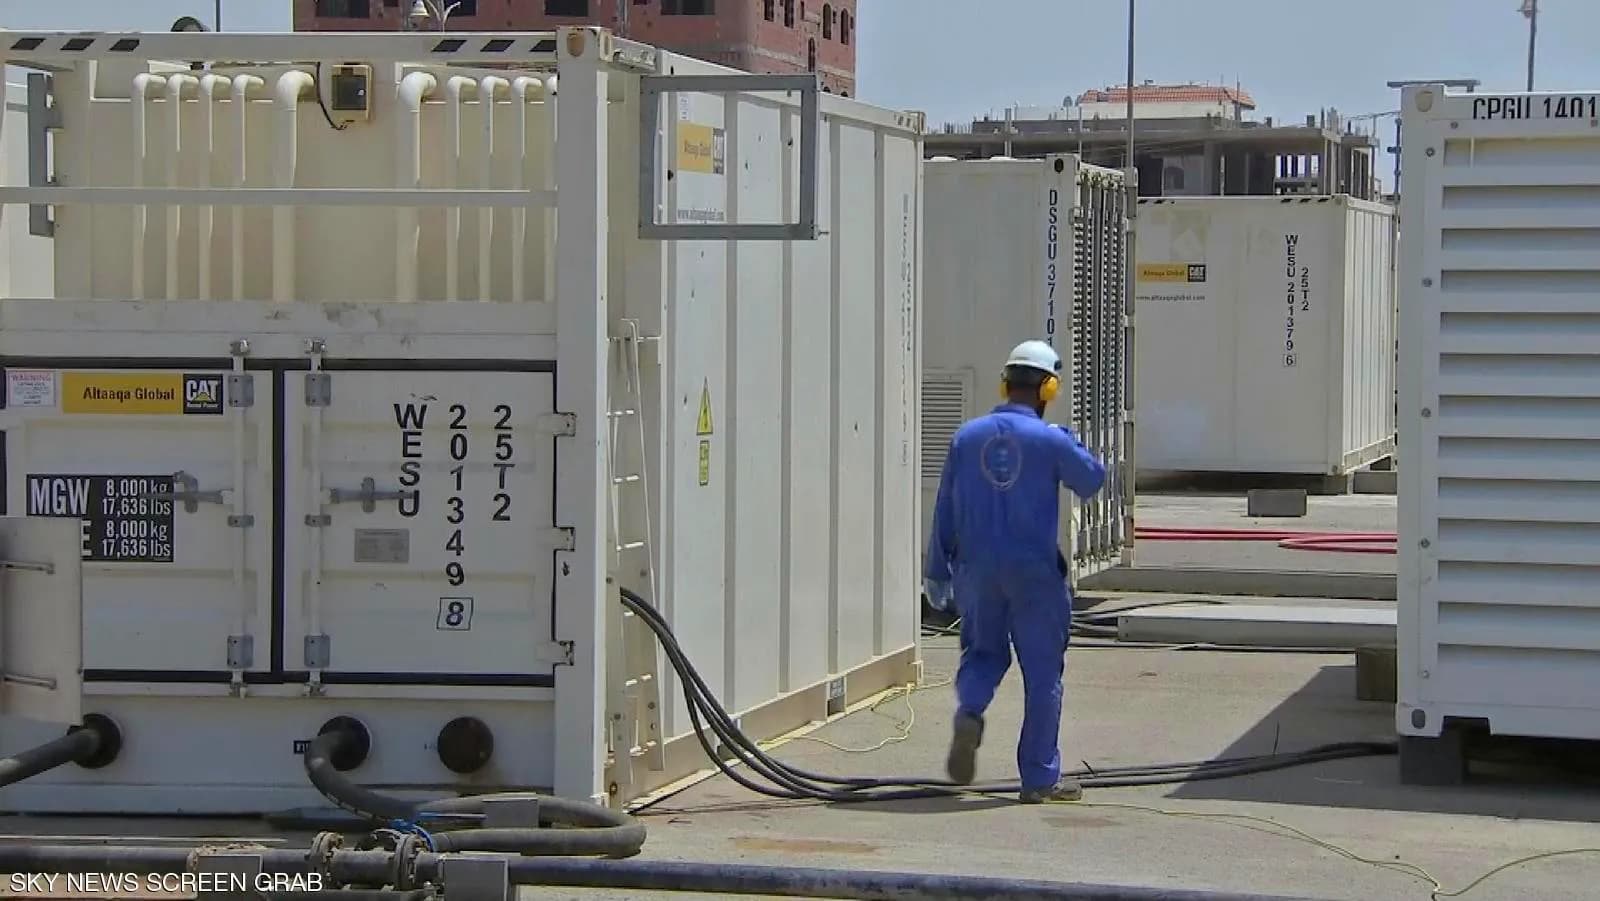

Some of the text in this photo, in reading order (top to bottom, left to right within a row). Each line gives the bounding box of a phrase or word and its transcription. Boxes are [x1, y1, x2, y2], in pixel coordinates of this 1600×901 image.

[1473, 96, 1597, 119] CPGU 1401
[1047, 190, 1058, 260] DSGU
[1285, 234, 1299, 278] WESU
[1301, 266, 1310, 311] 25T2
[1286, 282, 1295, 351] 201379
[83, 386, 175, 403] Altaaqa Global
[186, 379, 219, 402] CAT
[394, 403, 427, 517] WESU
[492, 404, 515, 521] 25T2
[30, 478, 91, 516] MGW
[105, 478, 147, 497] 8,000
[446, 404, 468, 587] 201349
[102, 498, 172, 517] 17,636 lbs
[102, 538, 147, 558] 17,636
[150, 539, 172, 557] lbs
[105, 519, 147, 540] 8,000
[150, 520, 168, 541] kg
